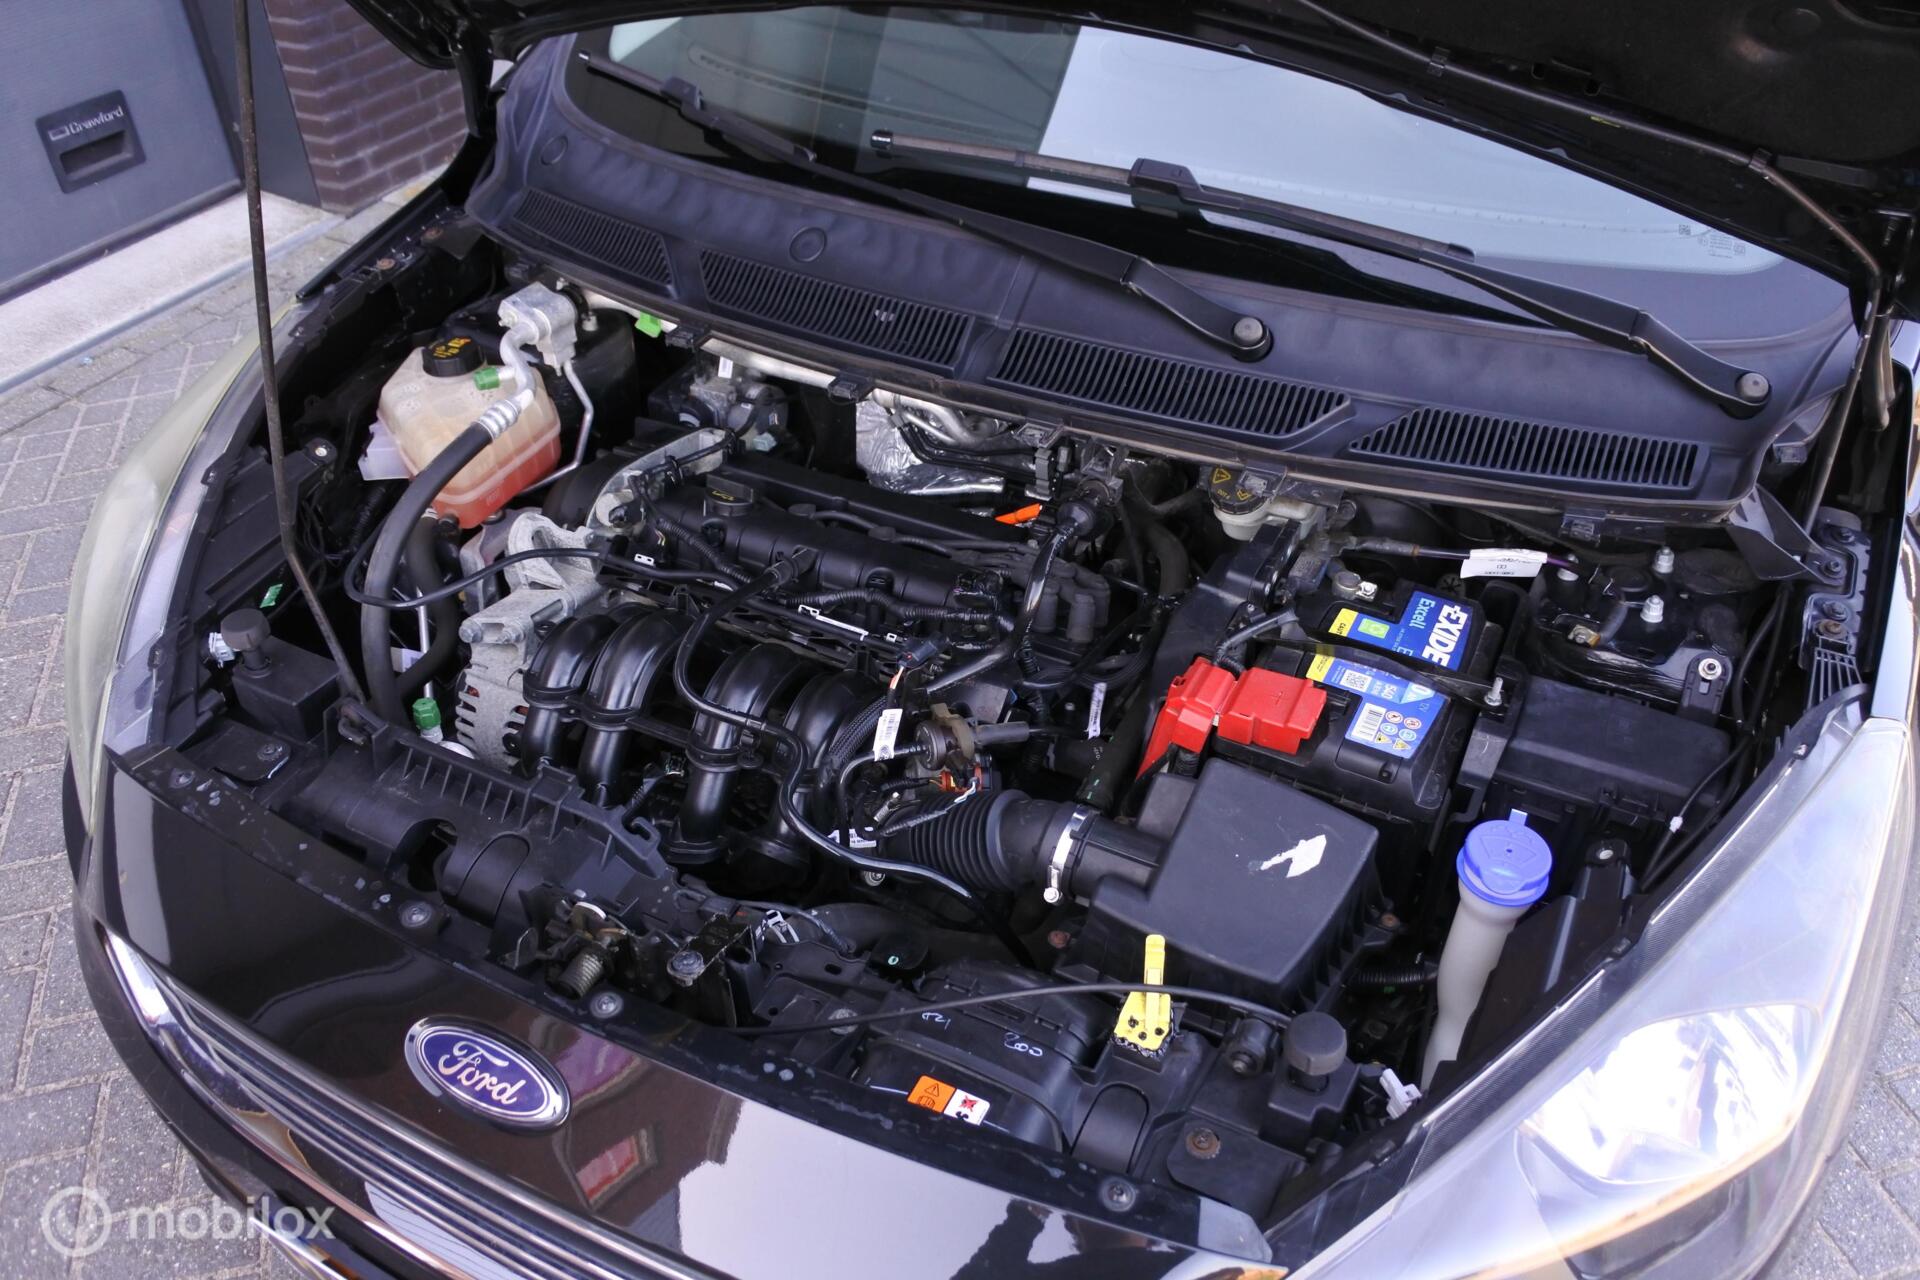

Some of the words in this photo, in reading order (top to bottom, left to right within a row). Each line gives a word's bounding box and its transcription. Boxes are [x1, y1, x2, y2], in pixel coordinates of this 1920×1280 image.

[69, 105, 124, 135] Crawford
[1409, 597, 1436, 629] Excell
[1422, 605, 1468, 667] EXIDE
[438, 1041, 526, 1105] Ford
